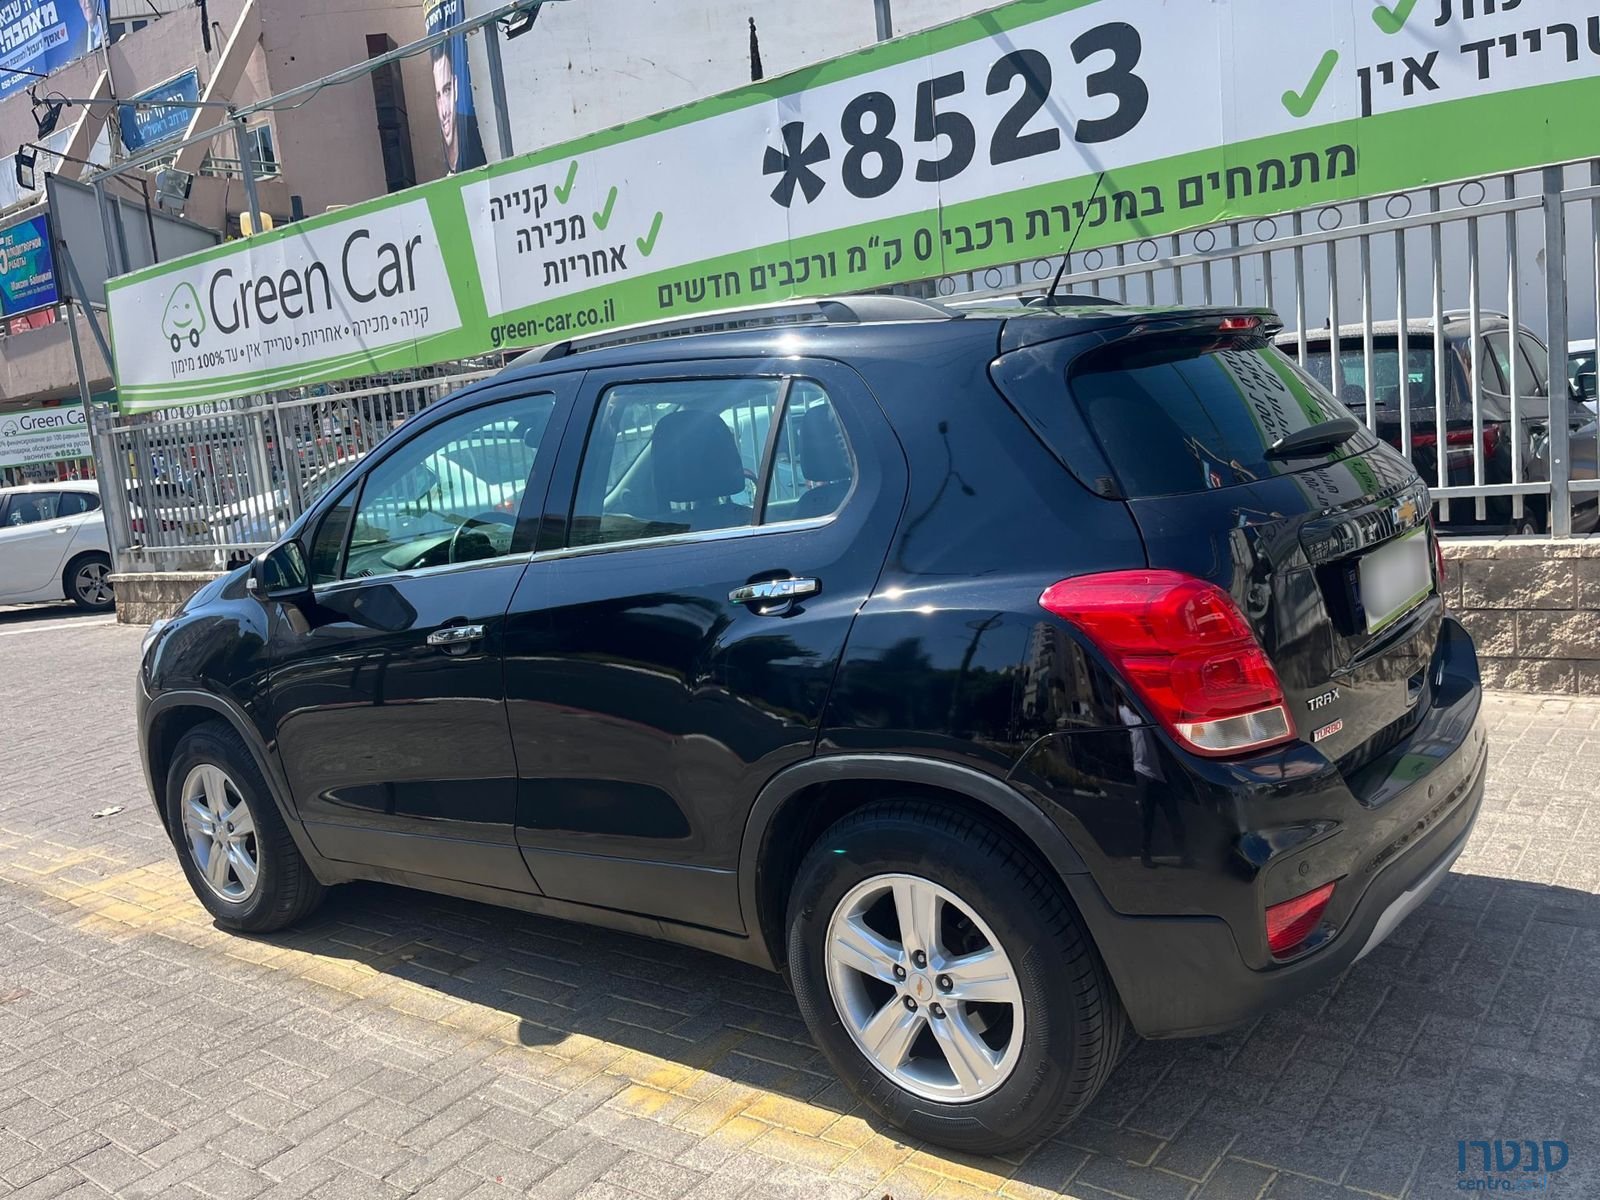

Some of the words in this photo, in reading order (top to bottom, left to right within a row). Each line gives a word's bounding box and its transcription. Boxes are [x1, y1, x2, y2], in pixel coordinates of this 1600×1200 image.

[1357, 50, 1440, 118] אין
[1177, 143, 1357, 210] מתמחים
[490, 184, 549, 222] קנייה
[1025, 183, 1165, 241] במכירת
[516, 214, 586, 254] מכירה
[942, 219, 1015, 255] רכבי
[543, 243, 628, 286] אחריות
[750, 251, 837, 292] ורכבים
[209, 261, 333, 335] Green
[342, 229, 422, 304] Car
[658, 269, 742, 309] חדשים
[352, 314, 390, 337] מכירה
[400, 306, 429, 328] קניה
[490, 299, 615, 347] green-car.co.il
[263, 335, 293, 354] טרייד
[301, 324, 342, 348] אחריות
[171, 356, 195, 379] מימון
[197, 349, 225, 370] 100%
[224, 347, 238, 363] עד
[245, 342, 261, 363] אין
[20, 415, 64, 430] Green
[66, 409, 86, 425] Ca
[1306, 688, 1340, 711] TRAX
[1315, 722, 1341, 740] TURBO
